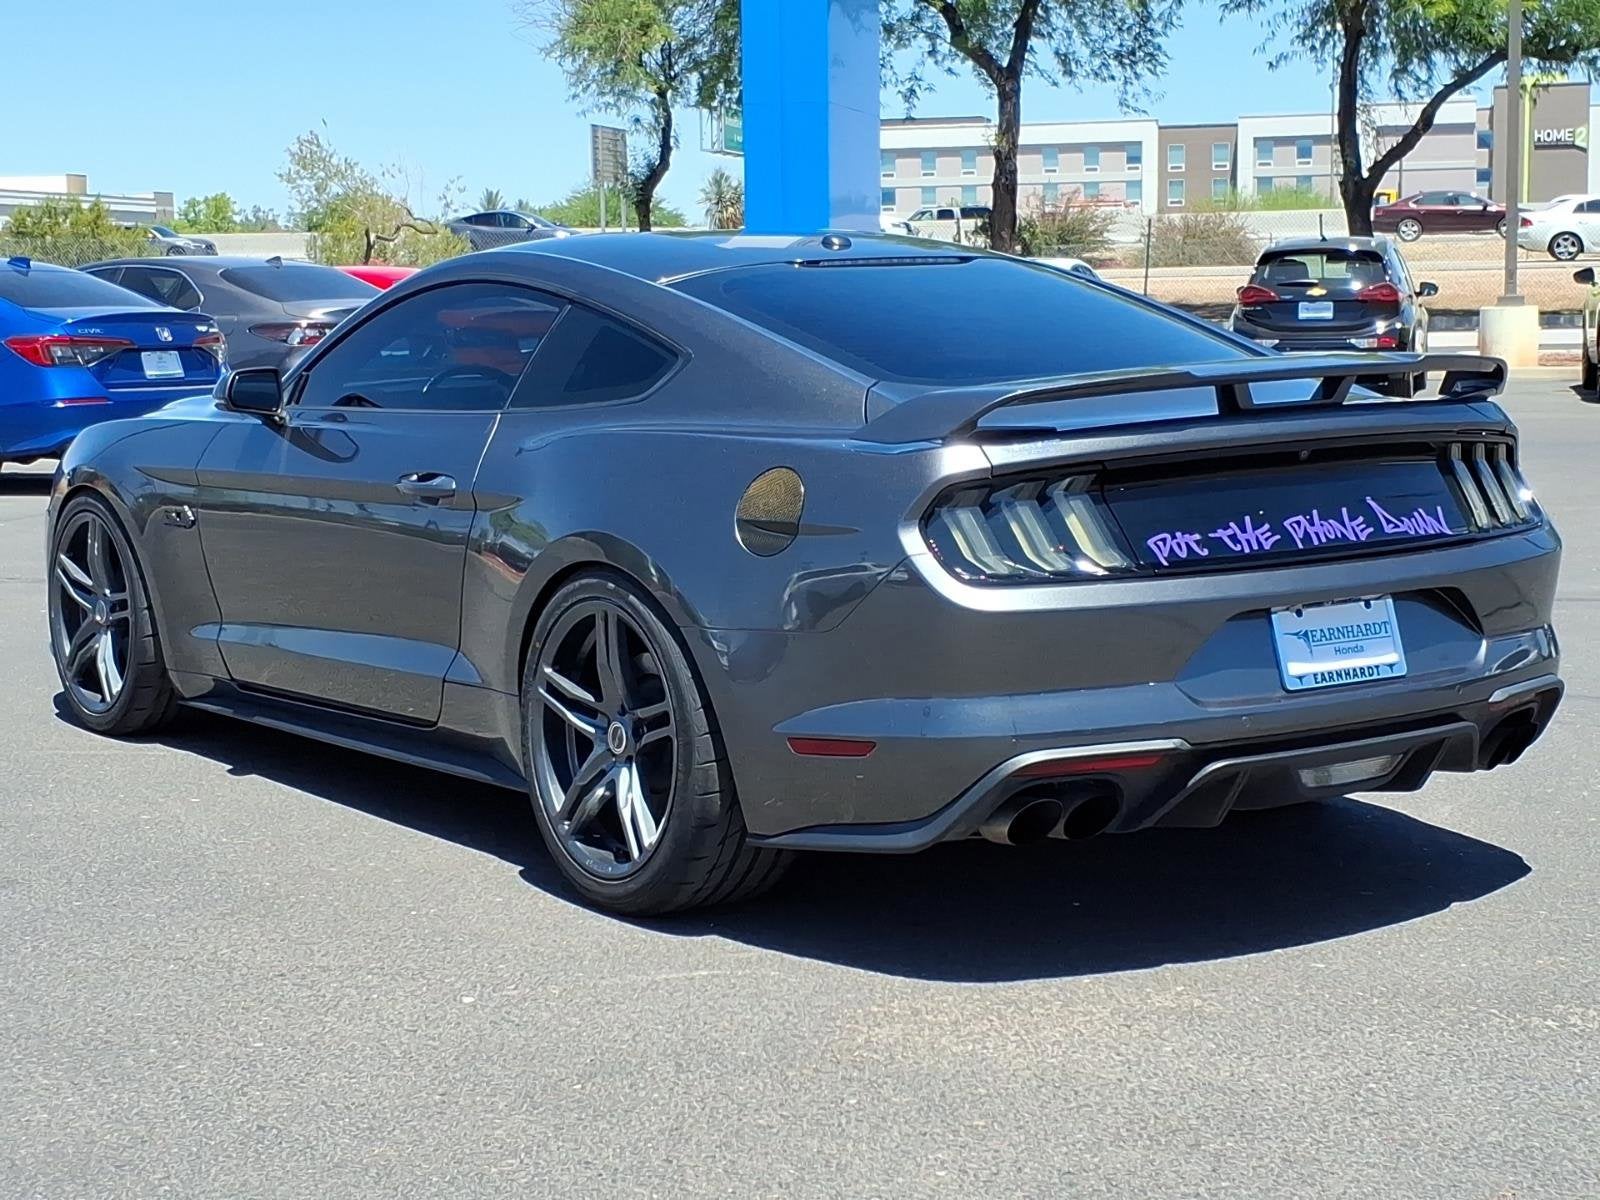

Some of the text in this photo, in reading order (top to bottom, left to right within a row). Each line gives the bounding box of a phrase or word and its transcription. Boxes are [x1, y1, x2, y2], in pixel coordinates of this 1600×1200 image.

[1309, 620, 1390, 643] EARNHARDT
[1334, 644, 1365, 656] Honda
[1313, 664, 1381, 685] EARNHARDT
